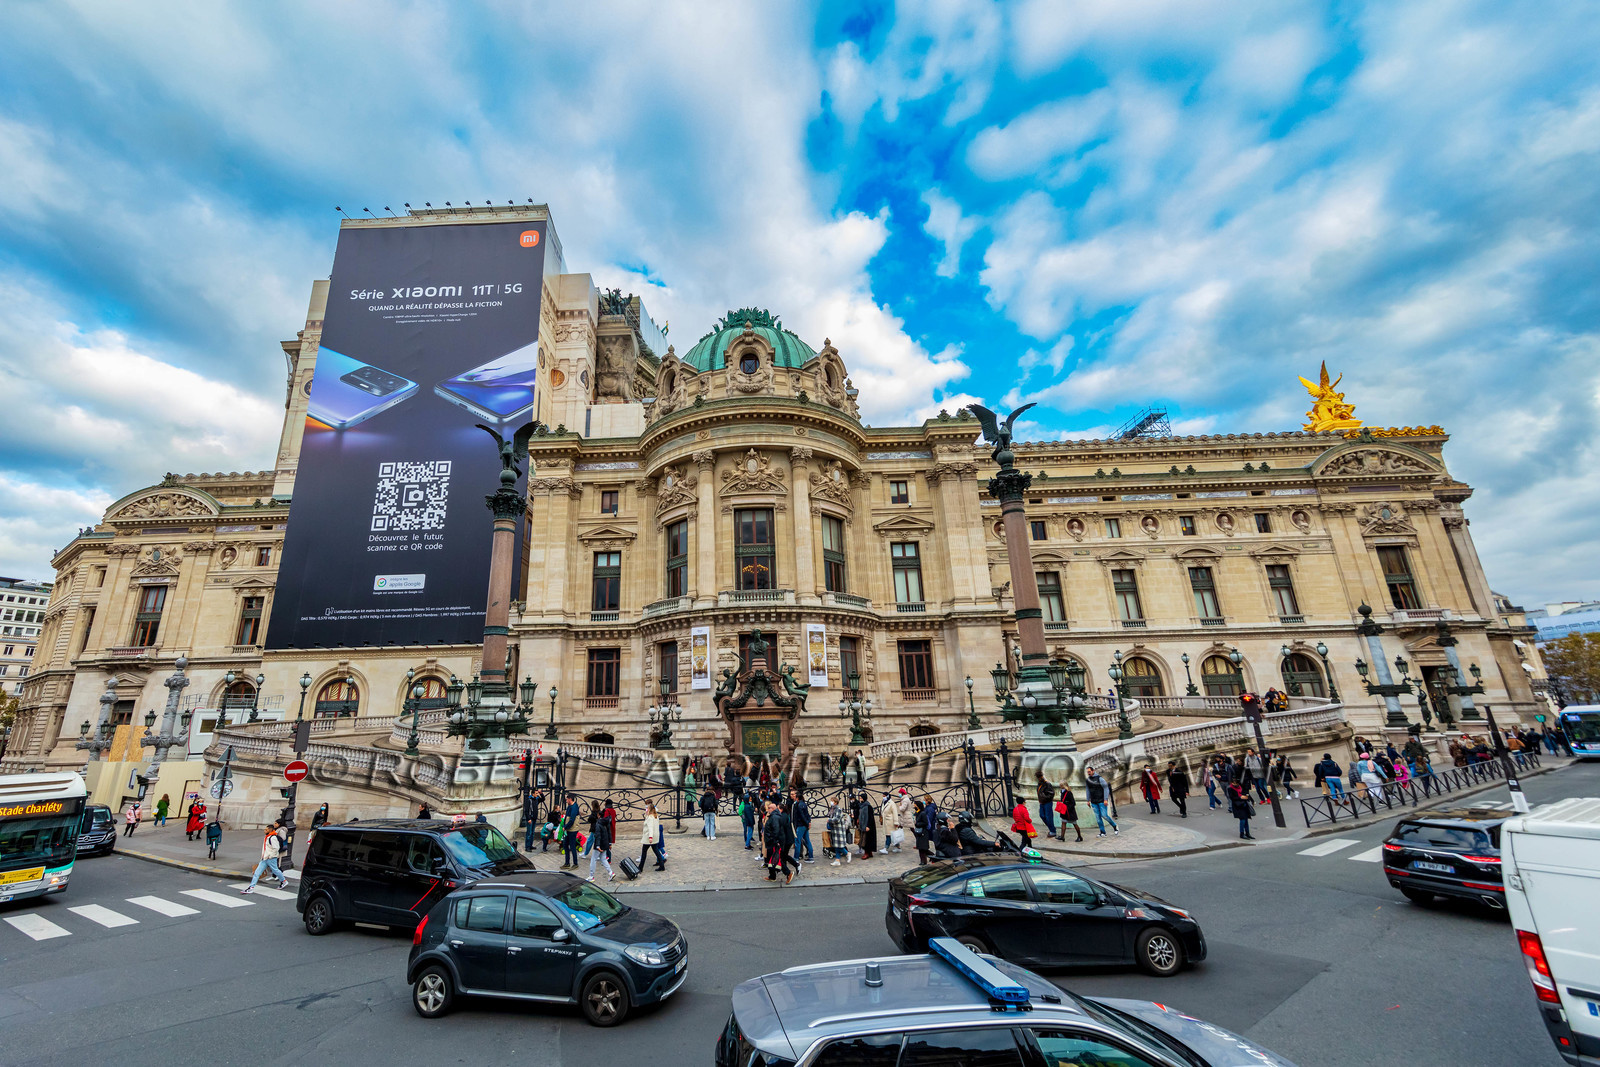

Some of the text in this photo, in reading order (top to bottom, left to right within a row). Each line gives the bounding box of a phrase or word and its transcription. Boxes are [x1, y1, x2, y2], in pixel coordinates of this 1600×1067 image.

[350, 289, 384, 300] Série
[472, 285, 494, 296] 11T
[504, 283, 522, 294] 5G
[368, 304, 394, 312] QUAND
[405, 302, 433, 310] RÉALITÉ
[434, 301, 463, 309] DÉPASSE
[475, 300, 503, 308] FICTION
[368, 534, 408, 542] Découvrez
[424, 533, 444, 541] futur,
[410, 543, 422, 551] QR
[0, 802, 63, 816] Stade Charléty
